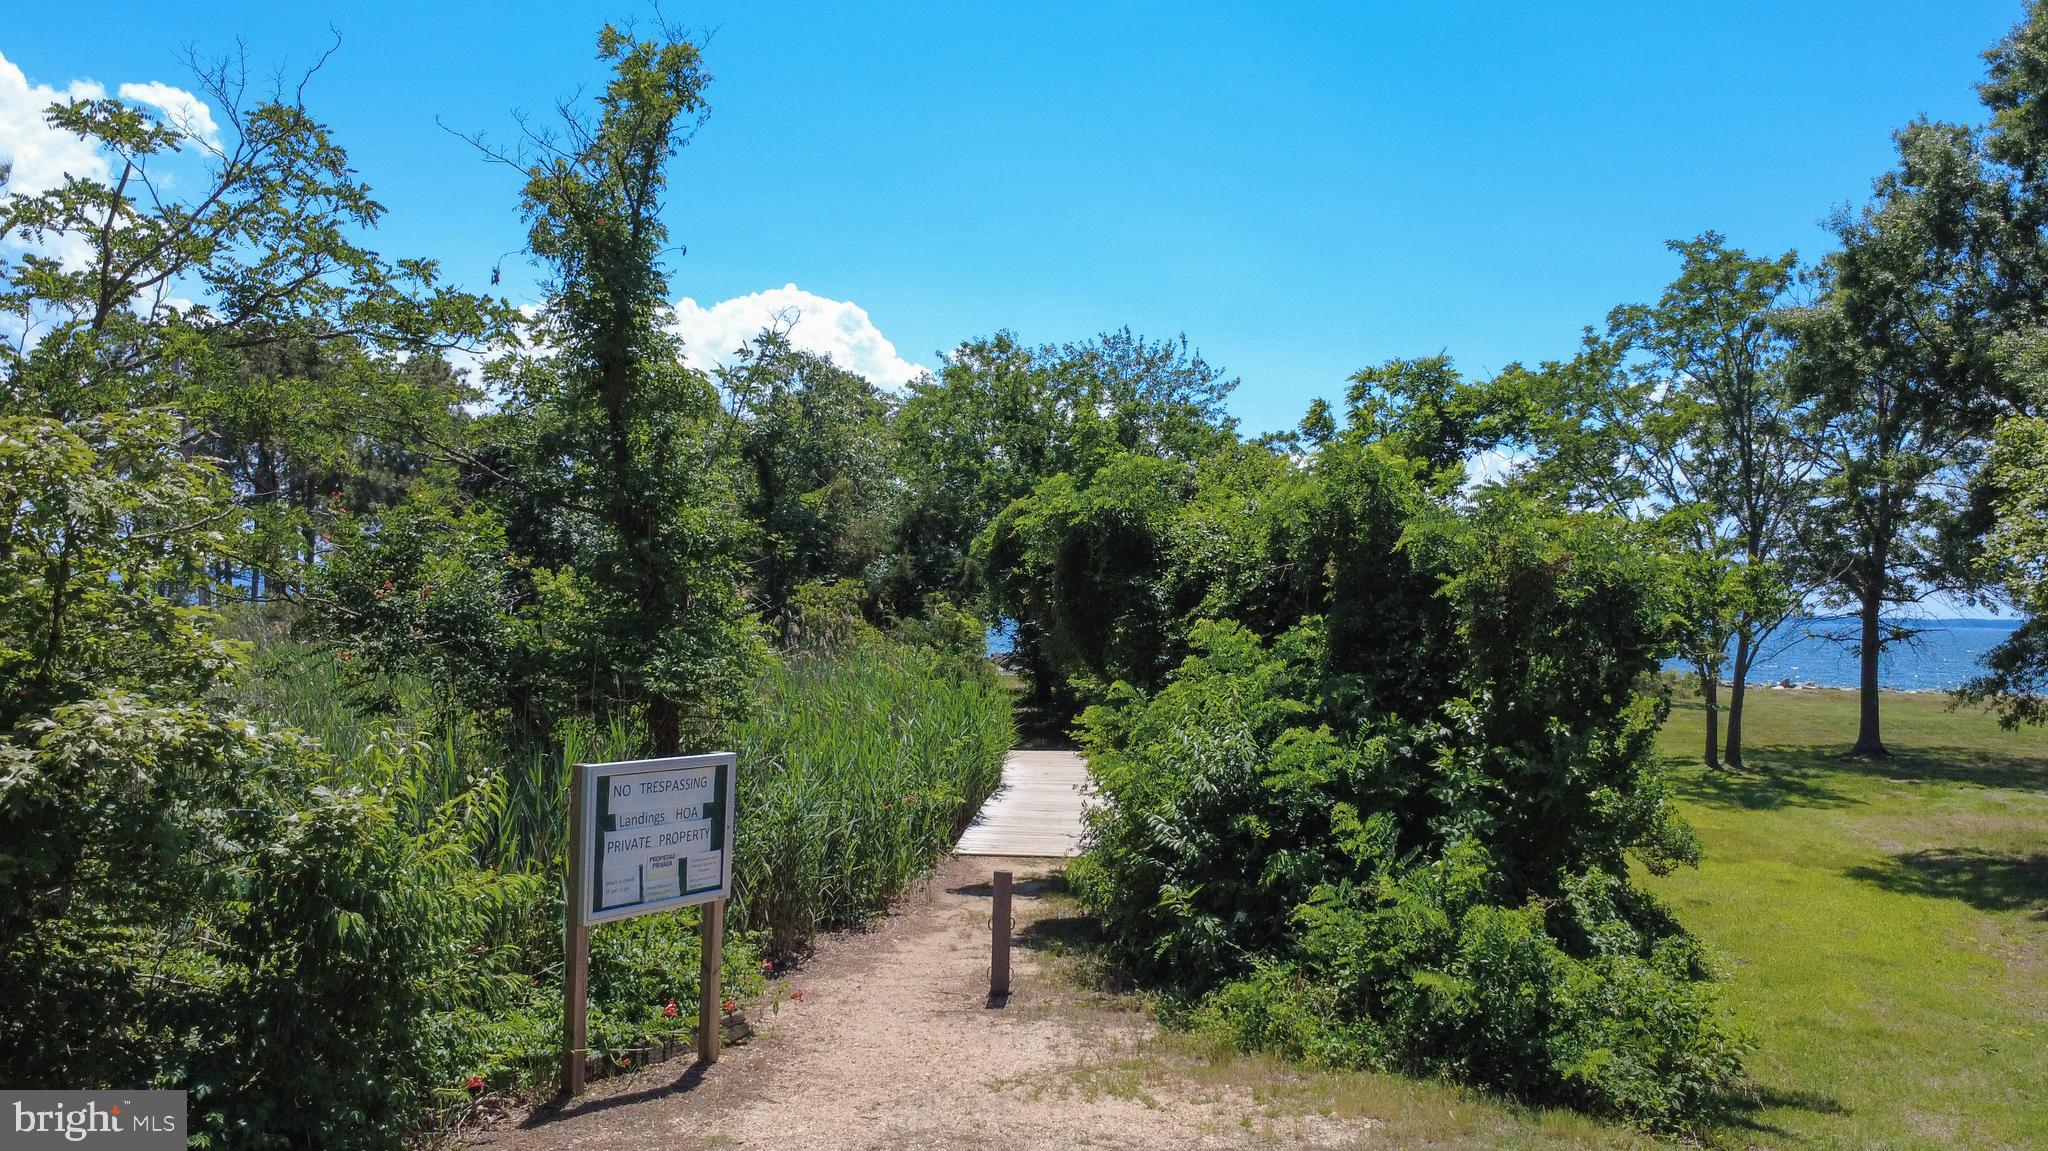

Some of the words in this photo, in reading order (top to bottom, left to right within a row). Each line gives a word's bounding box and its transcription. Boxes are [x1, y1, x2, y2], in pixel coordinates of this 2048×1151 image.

[613, 784, 632, 798] NO
[640, 776, 708, 795] TRESPASSING
[619, 811, 665, 827] Landings
[675, 806, 699, 820] HOA
[607, 835, 651, 854] PRIVATE
[659, 827, 711, 846] PROPERTY
